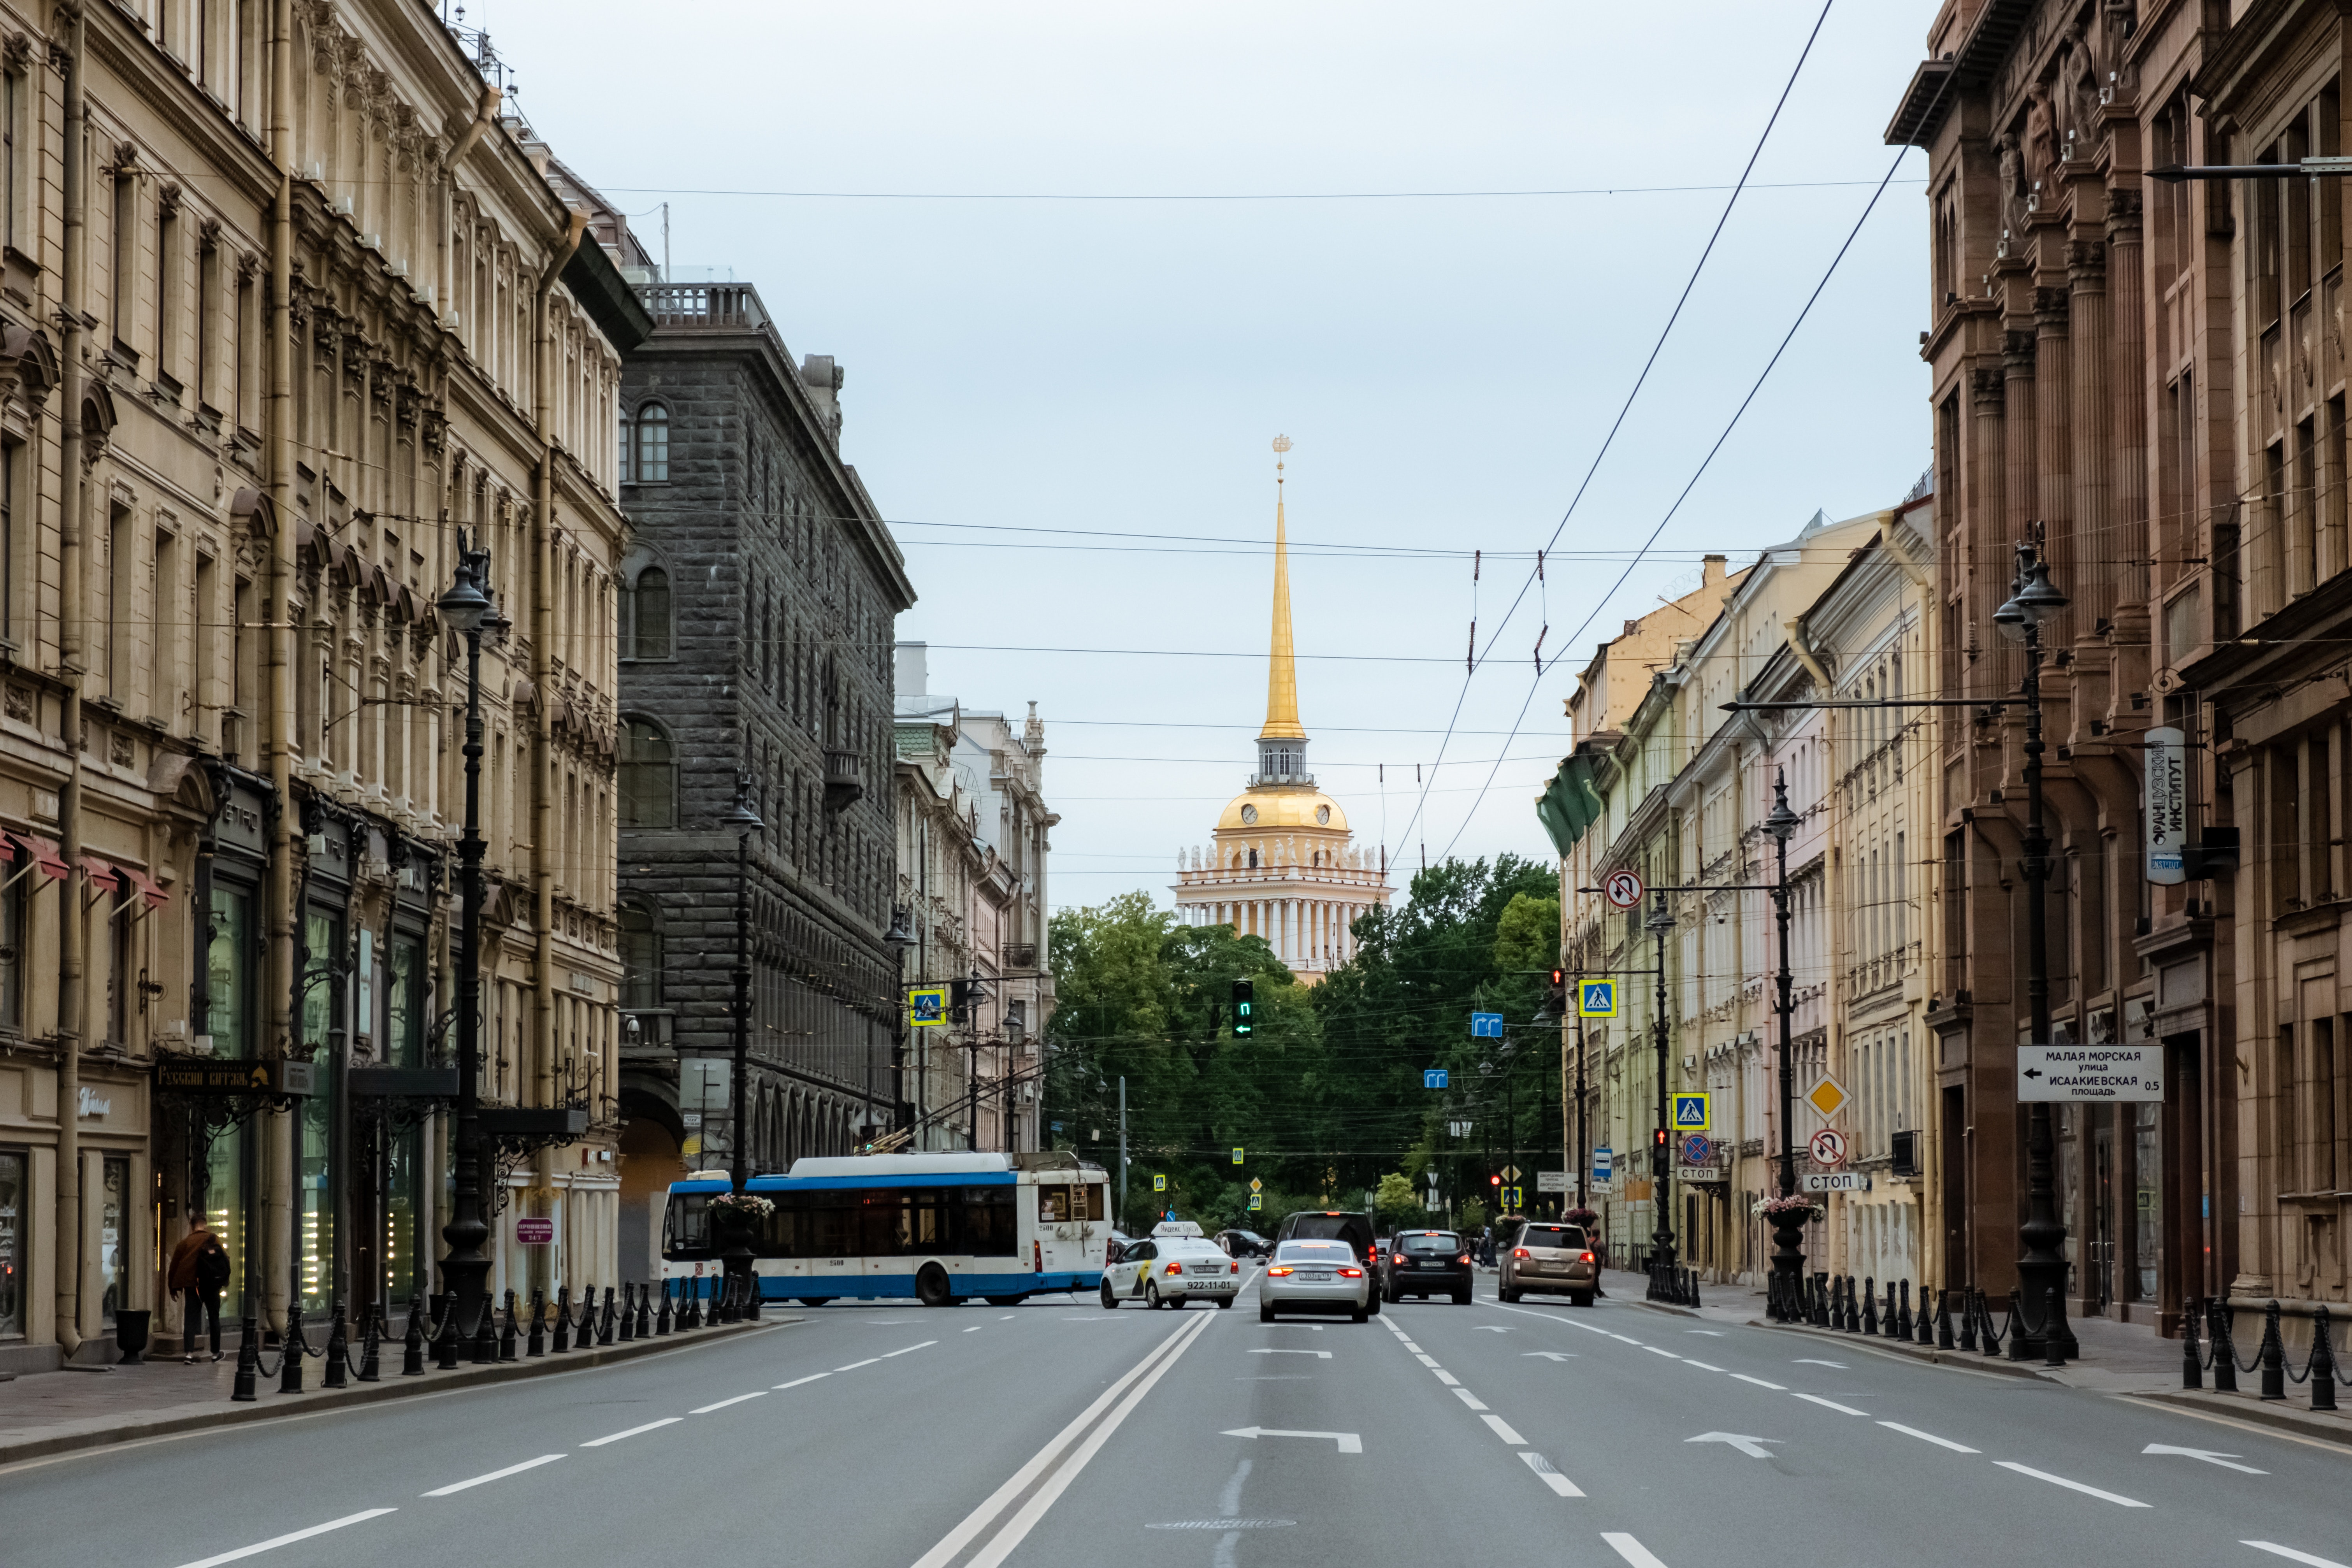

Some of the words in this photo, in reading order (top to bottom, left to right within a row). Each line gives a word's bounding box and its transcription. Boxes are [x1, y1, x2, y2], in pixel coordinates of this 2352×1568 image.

[2169, 757, 2182, 831] ИНСТИТУТ
[226, 801, 258, 830] ETRO
[2046, 1052, 2085, 1061] МАЛАЯ
[2089, 1052, 2141, 1061] МОРСКАЯ
[2078, 1063, 2108, 1073] улица
[2050, 1076, 2138, 1085] ИСААКИЕВСКАЯ
[2145, 1081, 2159, 1091] 0,5
[1682, 1169, 1713, 1178] СТОП
[1811, 1175, 1851, 1189] СТОП
[1161, 1224, 1181, 1233] Яндекс
[1182, 1224, 1199, 1233] Такси
[1187, 1281, 1230, 1289] 922-11-01
